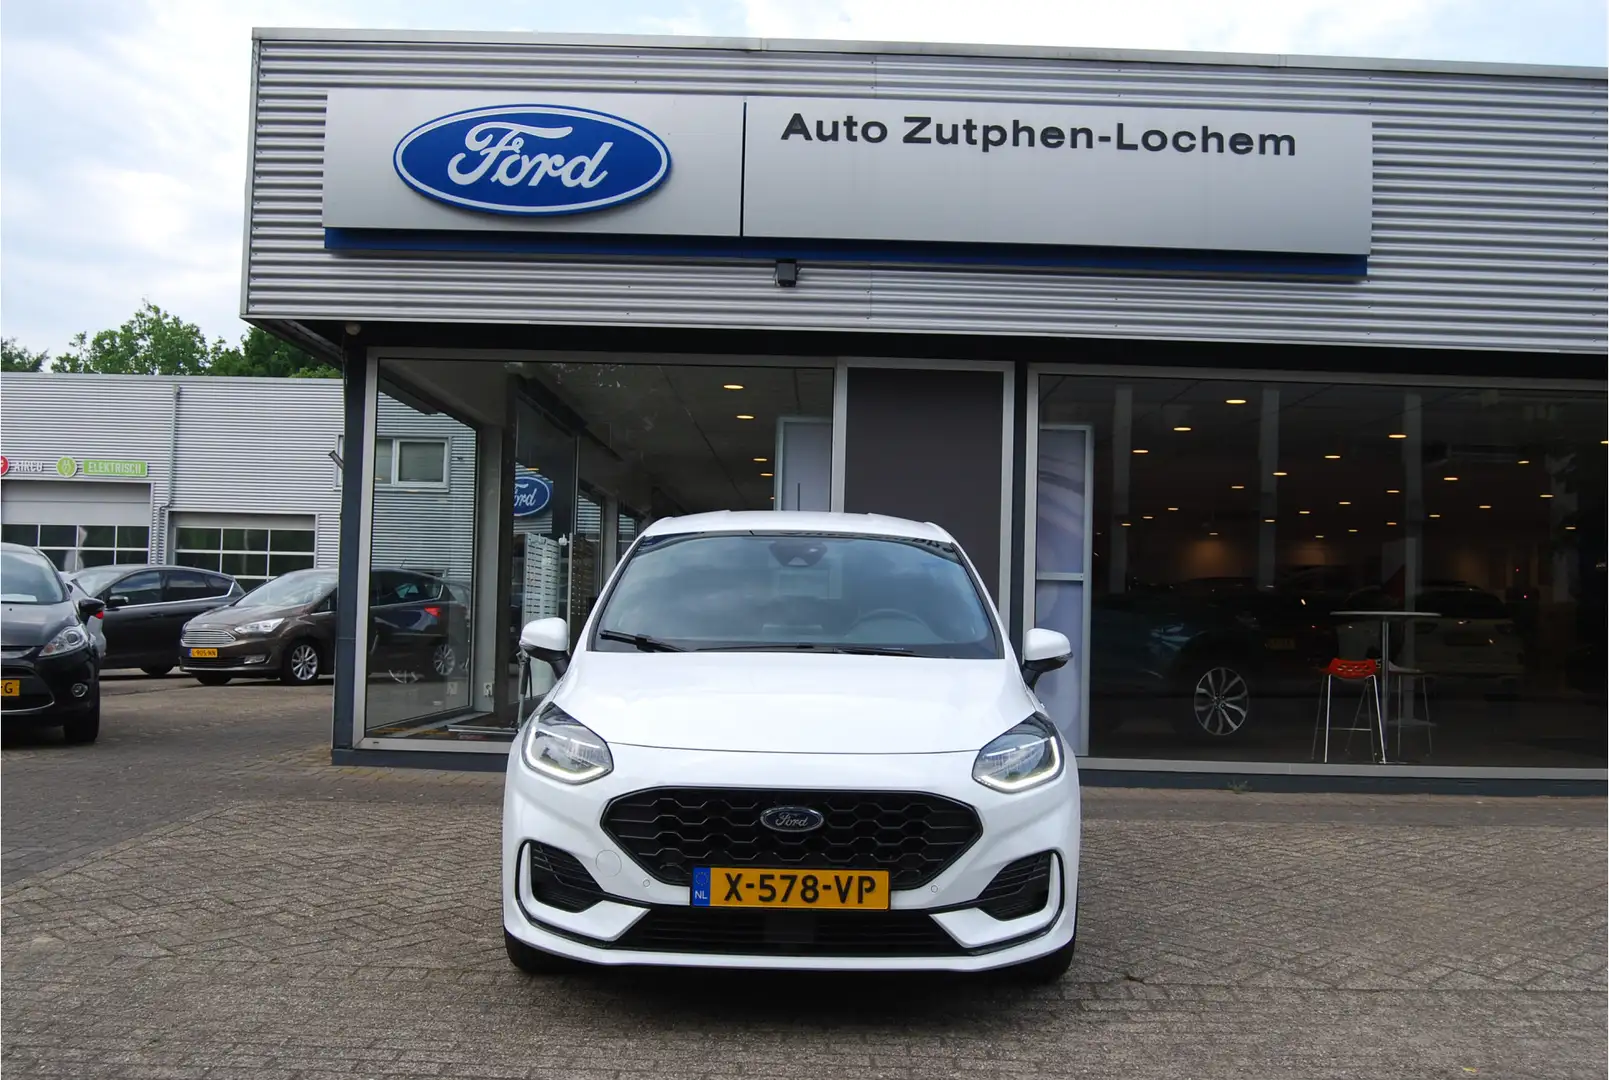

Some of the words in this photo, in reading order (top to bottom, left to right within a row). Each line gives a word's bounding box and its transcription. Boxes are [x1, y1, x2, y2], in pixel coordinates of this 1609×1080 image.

[780, 112, 888, 144] Auto
[902, 115, 1297, 157] Zutphen-Lochem
[447, 121, 614, 188] Ford
[88, 461, 141, 474] ELEKTRISCH
[775, 812, 809, 827] Ford
[694, 890, 708, 900] NL
[723, 872, 877, 905] X-578-VP
